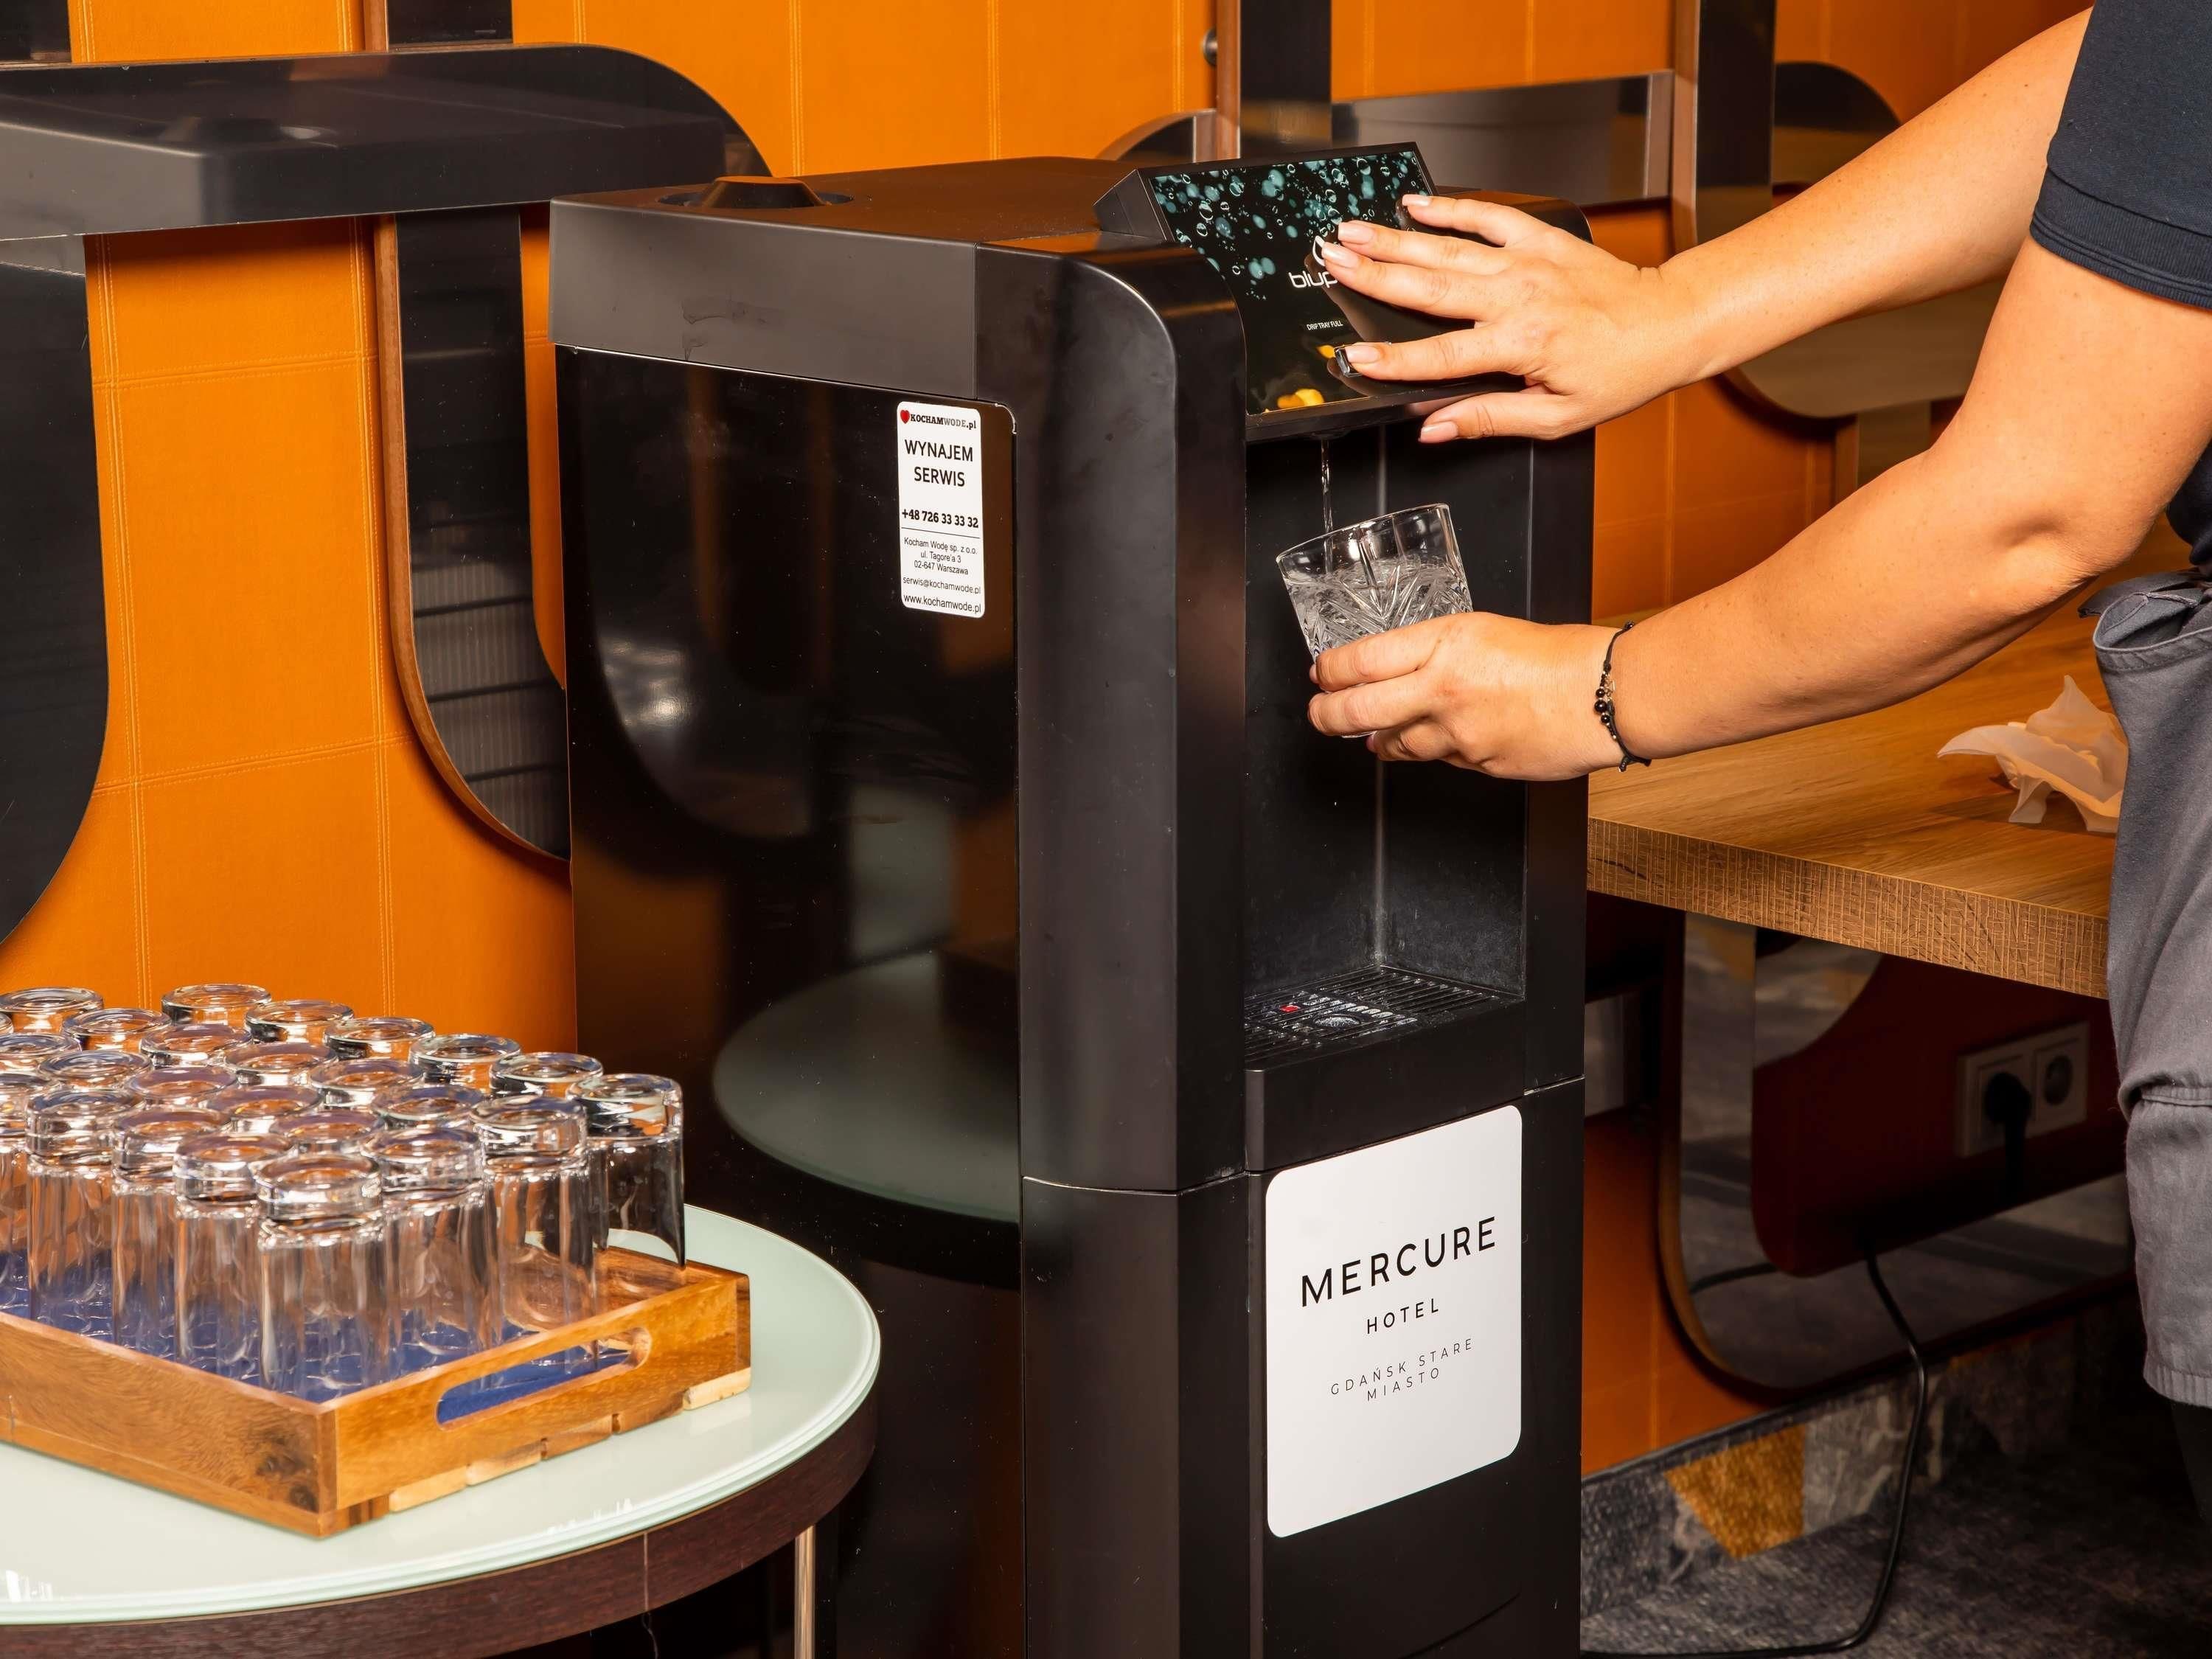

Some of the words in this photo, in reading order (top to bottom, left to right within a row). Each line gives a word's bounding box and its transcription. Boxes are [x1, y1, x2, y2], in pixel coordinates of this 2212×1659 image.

[1288, 270, 1338, 288] blup
[1307, 322, 1318, 330] DRIP
[910, 414, 976, 430] KOCHAMWODE.pl
[905, 439, 973, 462] WYNAJEM
[914, 466, 965, 487] SERWIS
[902, 509, 920, 521] +48
[922, 510, 939, 523] 726
[941, 513, 952, 525] 33
[954, 515, 965, 526] 33
[967, 517, 978, 529] 32
[904, 537, 929, 548] Kocham
[931, 540, 948, 552] Wodę
[950, 544, 959, 552] sp.
[914, 560, 935, 571] 02-647
[936, 563, 969, 575] Warszawa
[956, 555, 961, 563] 3
[902, 577, 981, 594] serwis@kochamwode.pl
[903, 594, 981, 614] www.kochamwode.pl
[1301, 1216, 1495, 1308] MERCURE
[1367, 1298, 1439, 1335] HOTEL
[1330, 1361, 1406, 1395] GDAŃSK
[1419, 1338, 1472, 1367] STARE
[1367, 1367, 1439, 1402] MIASTO
